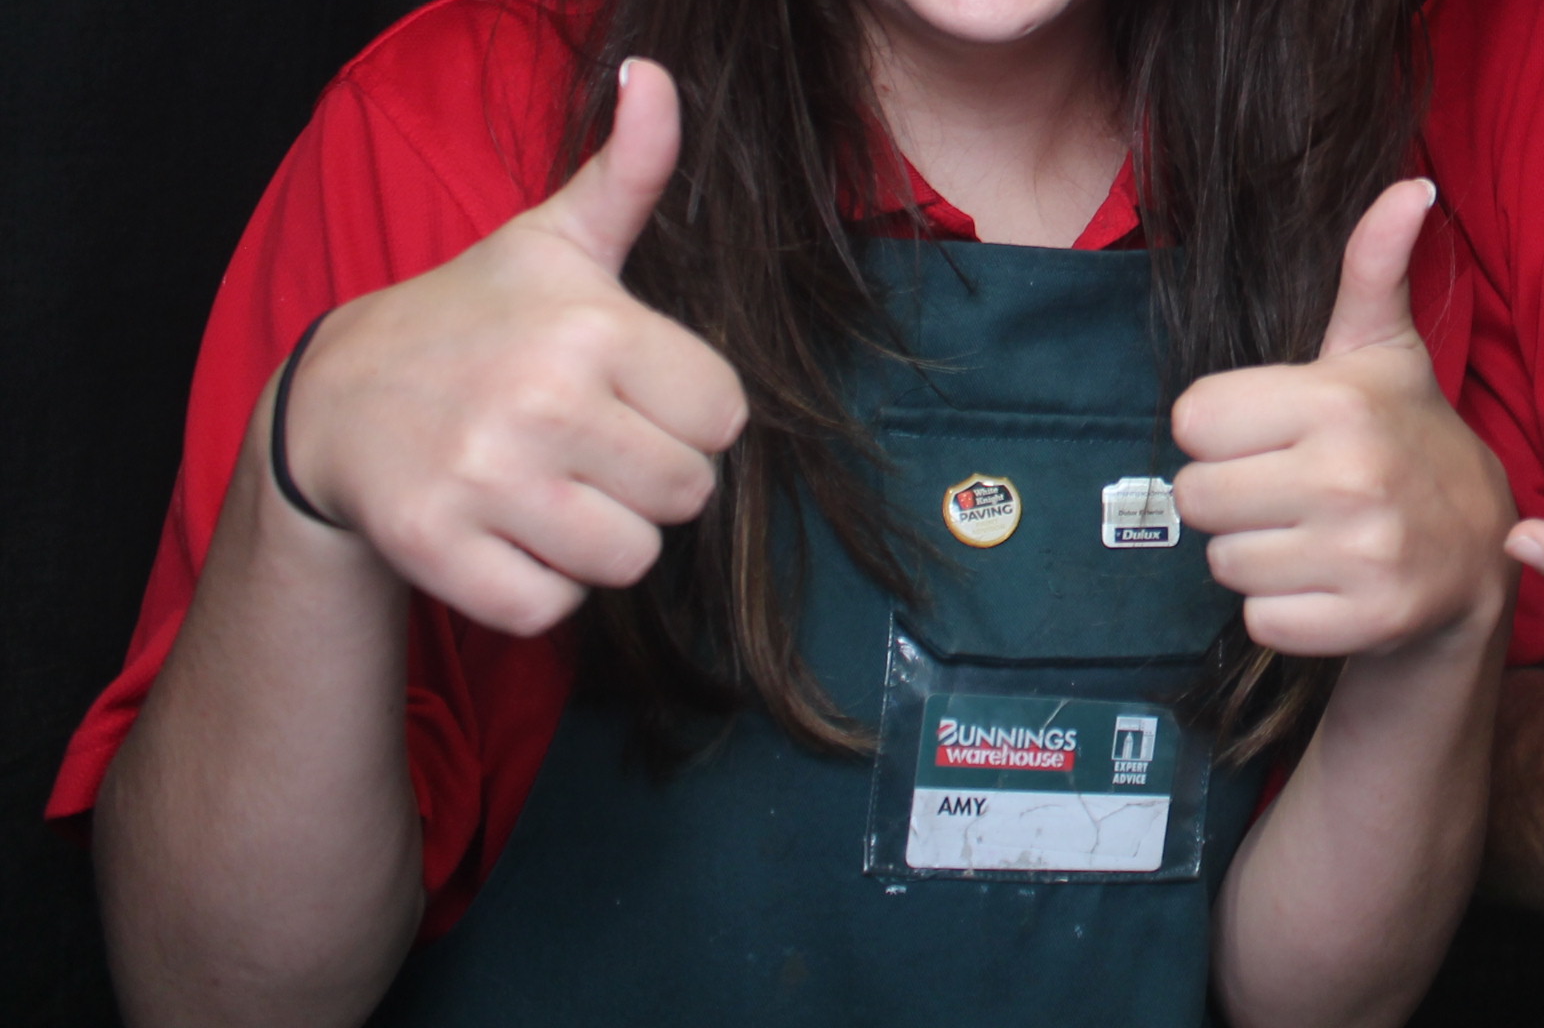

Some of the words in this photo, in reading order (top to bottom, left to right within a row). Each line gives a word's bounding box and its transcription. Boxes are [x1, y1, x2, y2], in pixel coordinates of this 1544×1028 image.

[973, 487, 999, 497] White
[975, 493, 1005, 506] Knight
[960, 504, 1013, 521] PAVING
[1121, 528, 1161, 541] Dulux
[936, 719, 1077, 752] BUNNINGS
[947, 747, 1064, 768] warehouse
[1114, 761, 1149, 773] EXPERT
[1112, 773, 1147, 785] ADVICE
[937, 796, 986, 816] AMY
